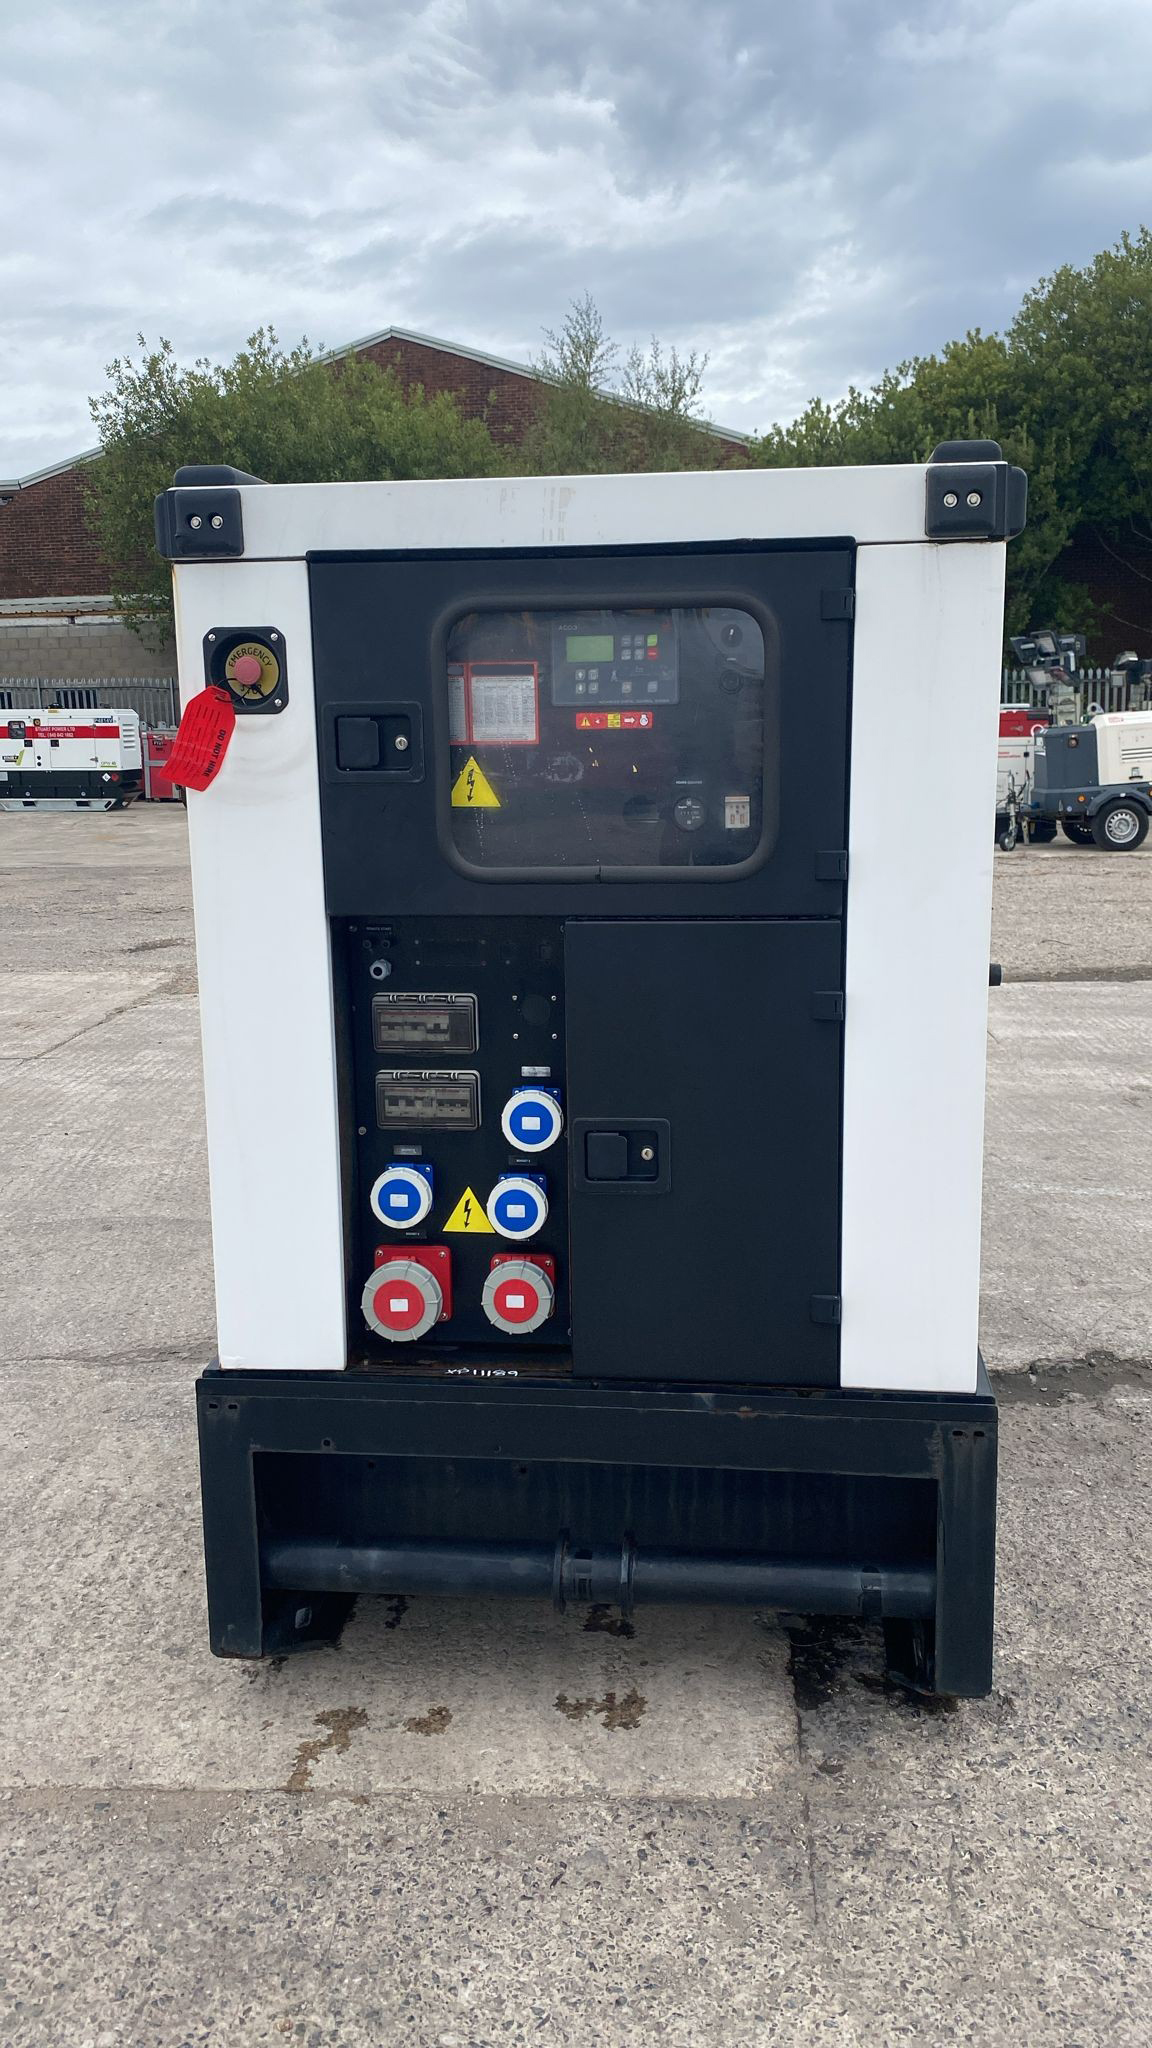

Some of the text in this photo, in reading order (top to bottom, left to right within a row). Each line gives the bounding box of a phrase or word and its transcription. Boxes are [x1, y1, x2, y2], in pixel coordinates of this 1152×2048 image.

[228, 647, 272, 667] EMERGENCY
[203, 729, 226, 777] DO NOT HIRE
